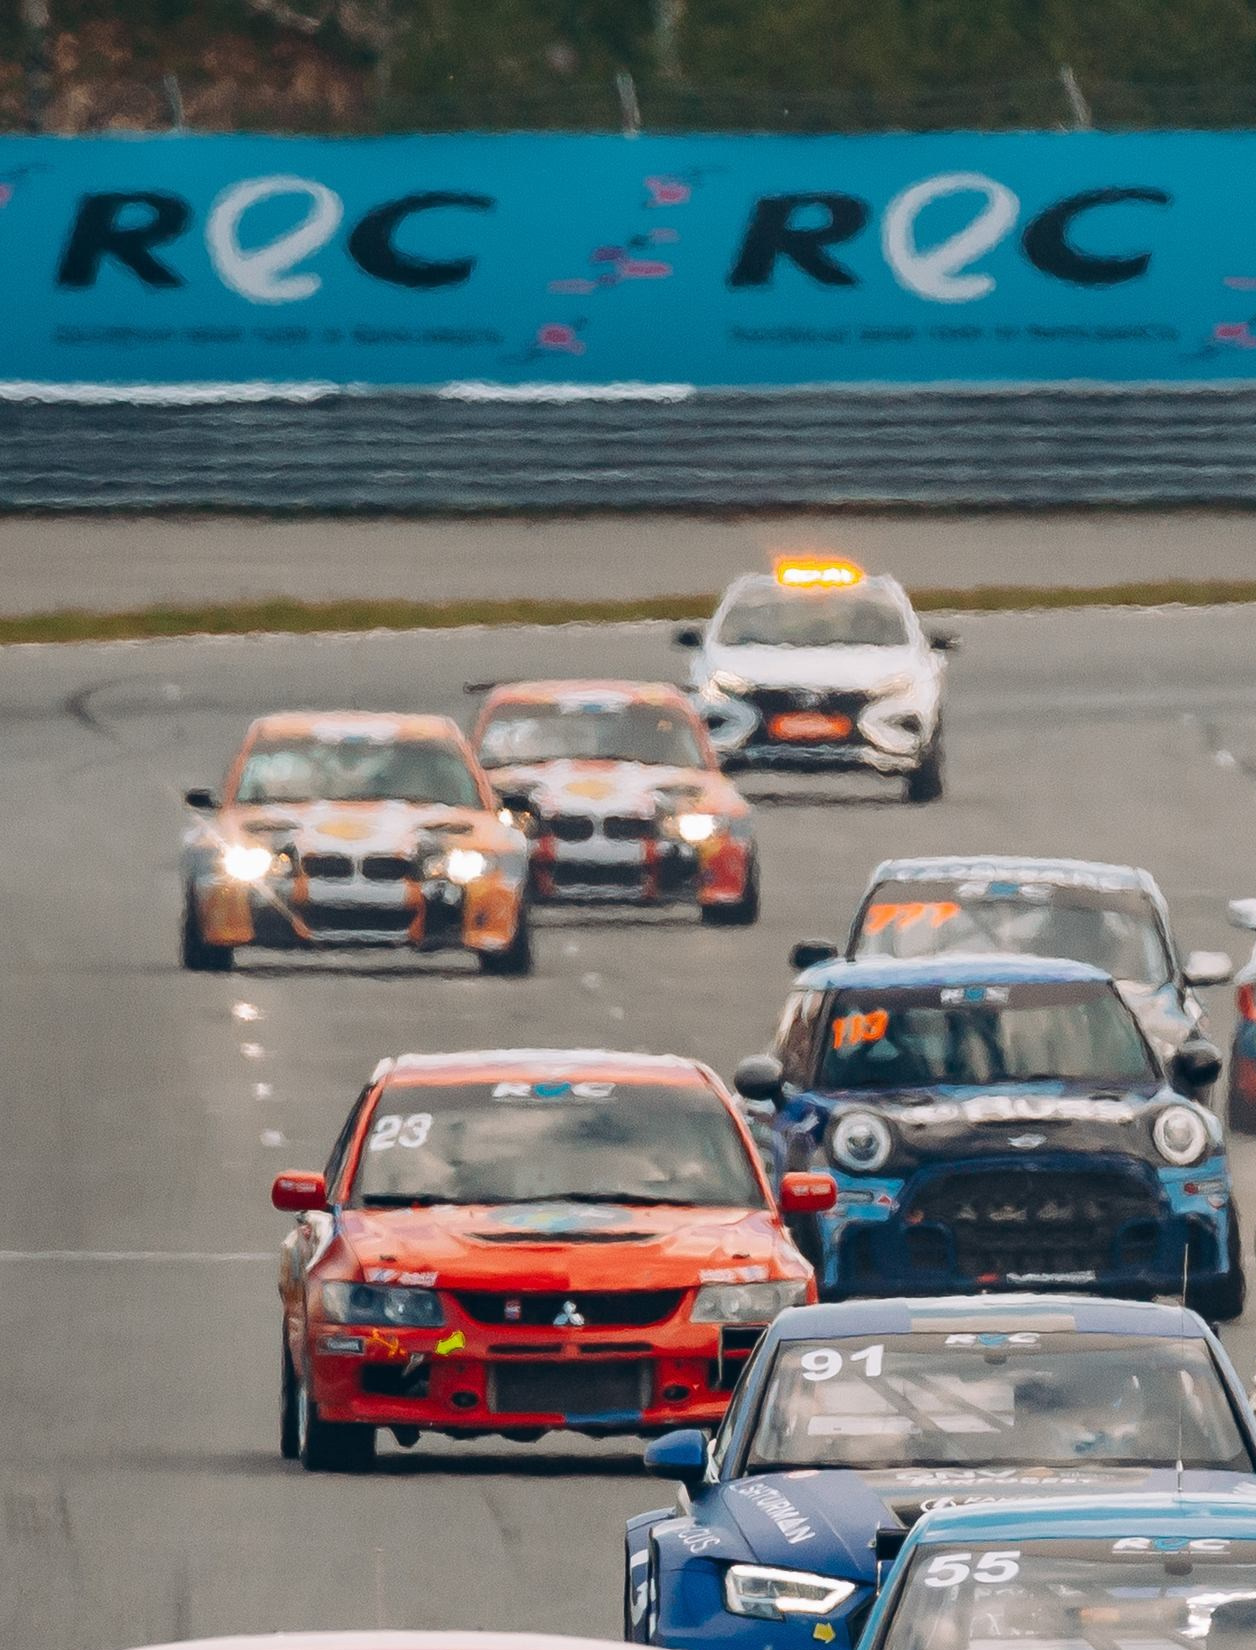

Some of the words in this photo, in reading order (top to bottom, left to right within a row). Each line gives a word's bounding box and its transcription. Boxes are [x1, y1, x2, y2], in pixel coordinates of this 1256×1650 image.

[370, 1113, 433, 1151] 23
[800, 1344, 885, 1382] 91
[924, 1550, 1021, 1588] 55
